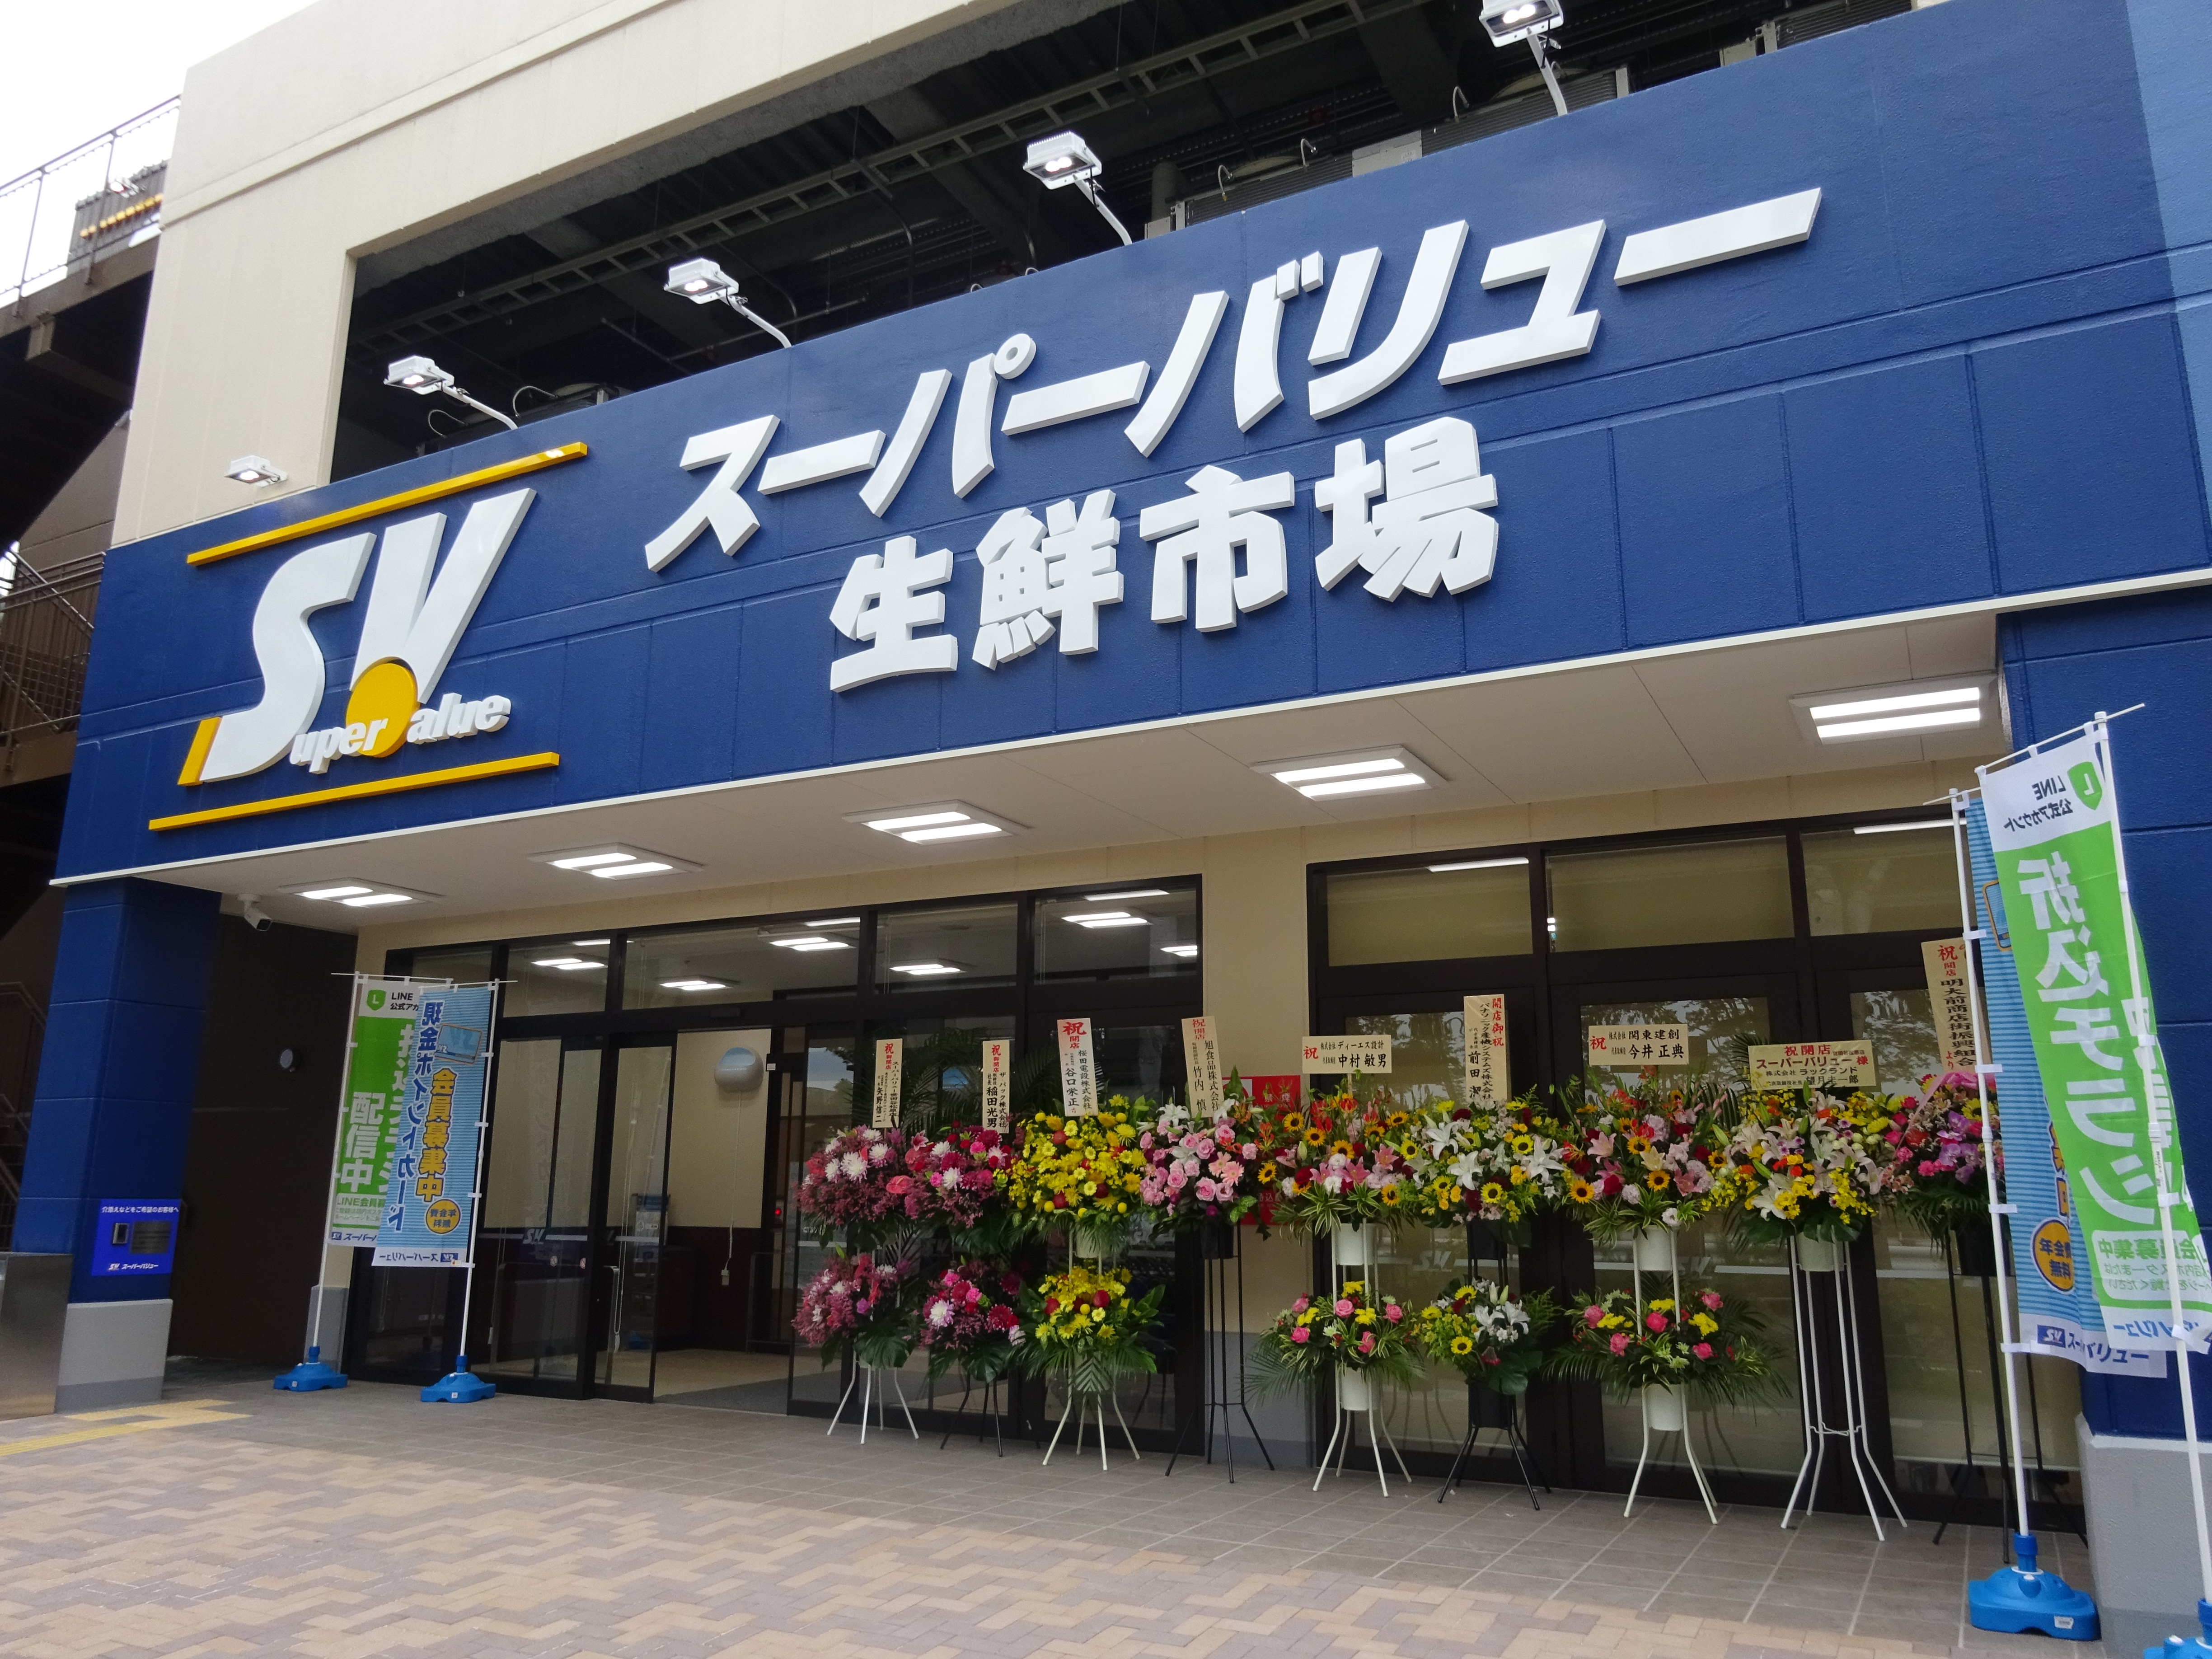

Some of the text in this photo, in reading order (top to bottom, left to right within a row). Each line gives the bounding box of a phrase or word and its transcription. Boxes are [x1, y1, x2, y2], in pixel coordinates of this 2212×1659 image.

[644, 187, 1823, 572] スーパーバリュー
[829, 416, 1499, 693] 生鮮市場
[391, 992, 414, 1001] LINE
[1492, 998, 1504, 1046] 開店御祝
[1629, 1029, 1679, 1040] 関東建創
[1303, 1046, 1319, 1059] 祝
[1338, 1040, 1384, 1050] ディーエス設計
[1589, 1036, 1607, 1050] 祝
[1784, 1044, 1832, 1056] 祝開店
[1078, 1050, 1092, 1109] 桜田電設株式会社
[1204, 1040, 1219, 1111] 旭食品株式会社
[1756, 1056, 1852, 1069] スーパーバリュー
[1800, 1066, 1858, 1076] ラックランド
[875, 1087, 883, 1122] 矢野信二
[1064, 1068, 1079, 1106] 谷口栄正
[986, 1087, 998, 1128] 稲田光男
[341, 1092, 386, 1192] 配信中
